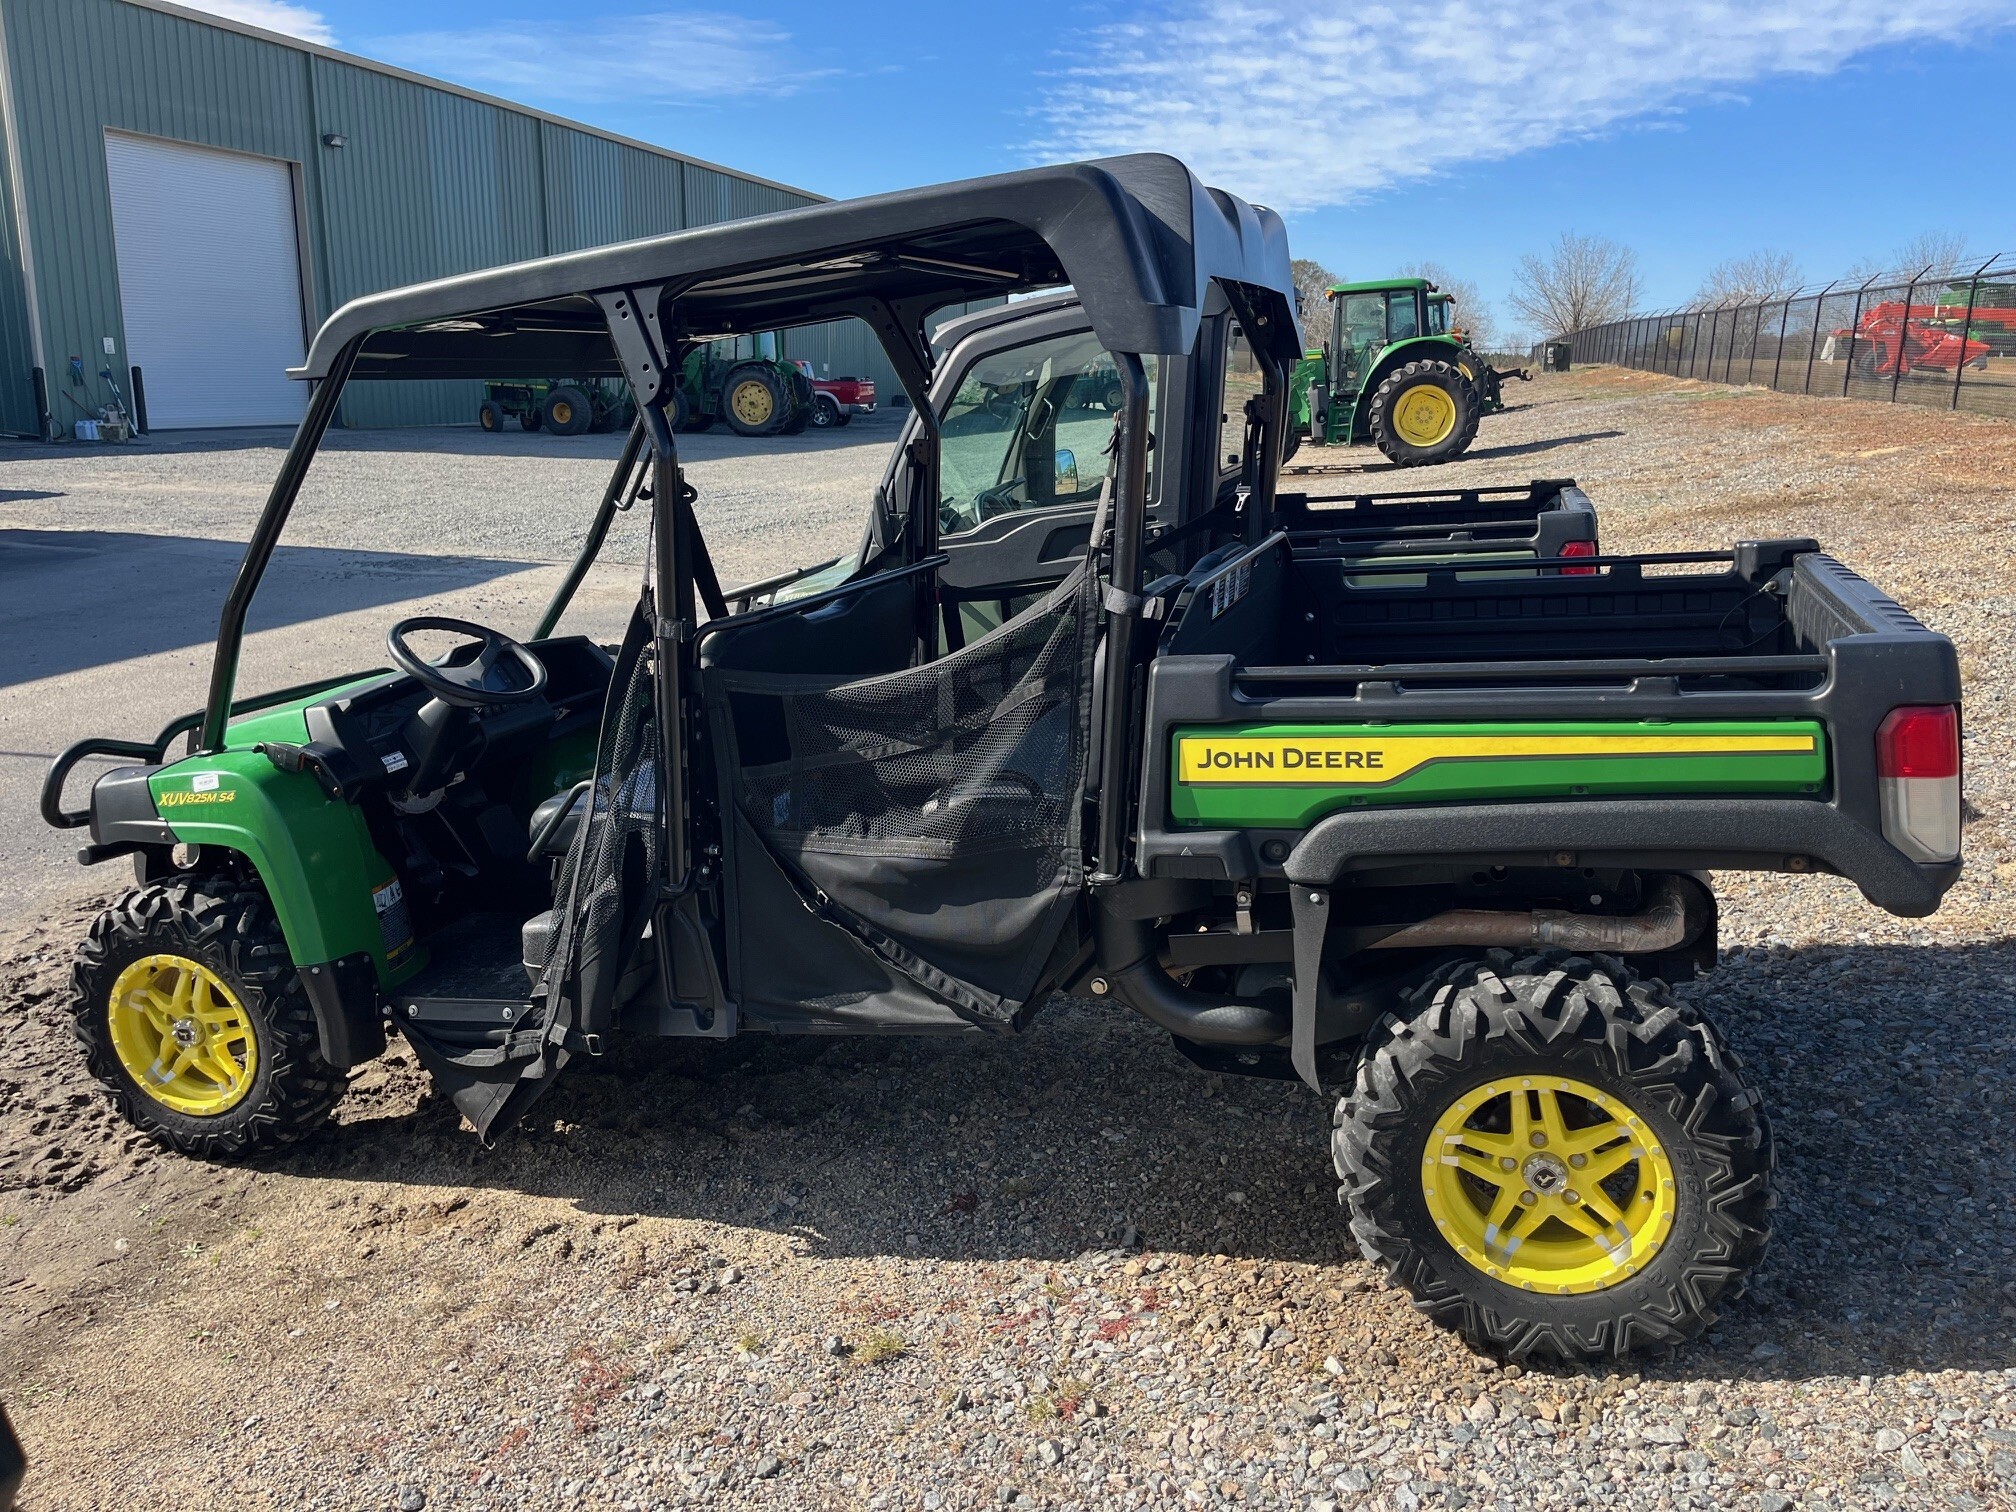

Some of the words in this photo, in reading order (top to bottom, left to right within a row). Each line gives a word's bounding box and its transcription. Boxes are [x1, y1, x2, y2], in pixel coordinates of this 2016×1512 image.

[1197, 748, 1274, 769] JOHN
[1282, 747, 1384, 769] DEERE
[158, 791, 218, 807] XUV825M
[218, 791, 236, 803] S4
